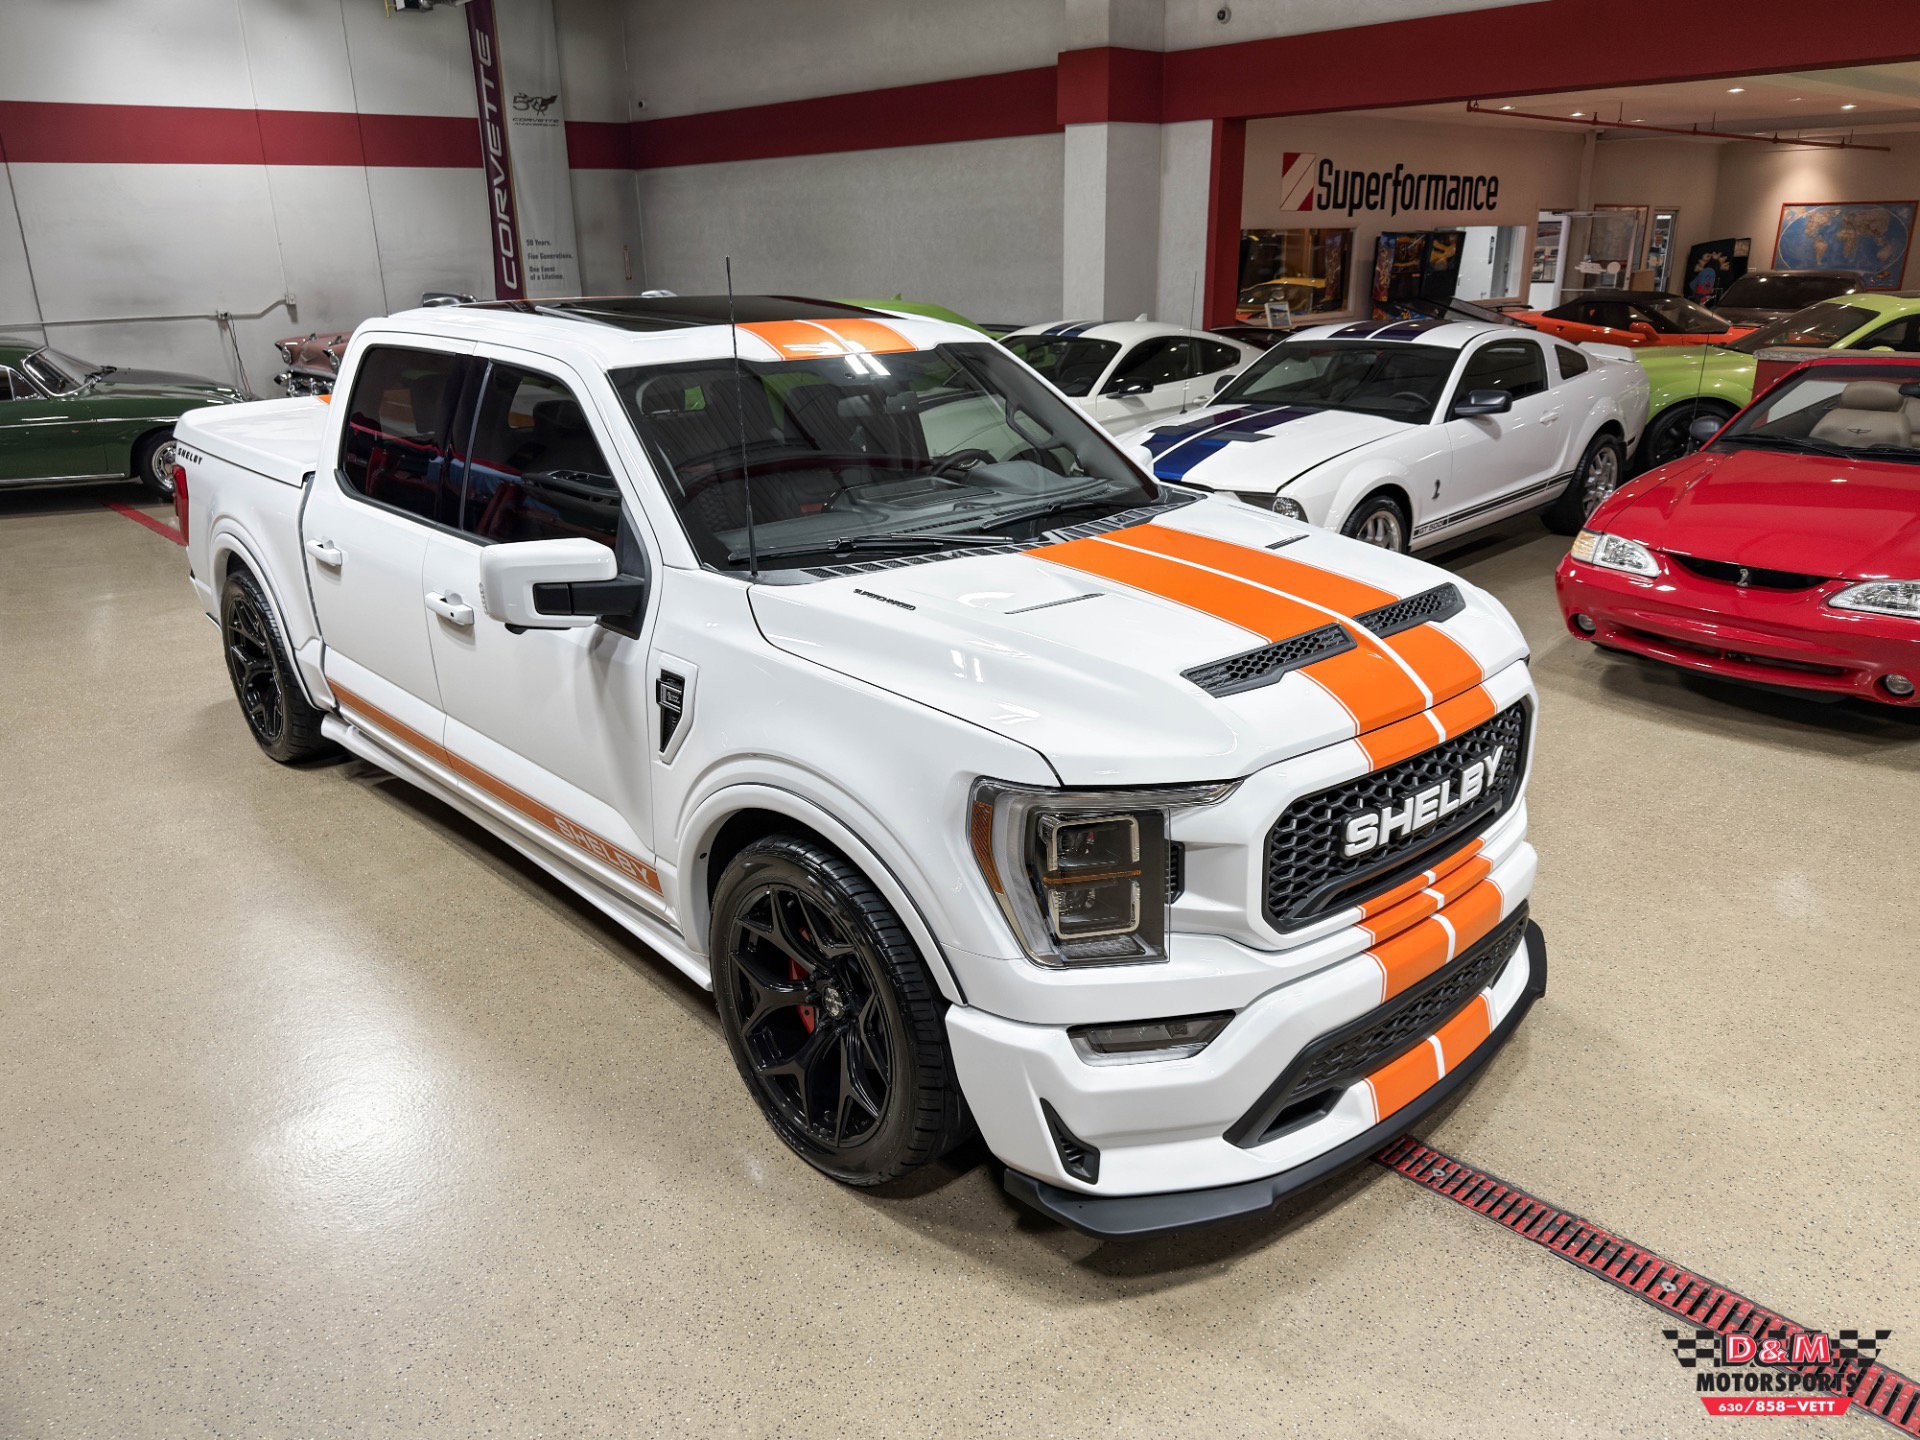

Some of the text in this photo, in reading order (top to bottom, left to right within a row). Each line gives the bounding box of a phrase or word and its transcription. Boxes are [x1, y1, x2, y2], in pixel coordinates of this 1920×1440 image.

[475, 28, 518, 291] CORVETTE
[1317, 158, 1499, 217] Superformance
[177, 447, 204, 466] SHELBY
[1419, 520, 1444, 534] GT 500
[1343, 745, 1504, 858] SHELBY
[553, 816, 651, 886] SHELBY
